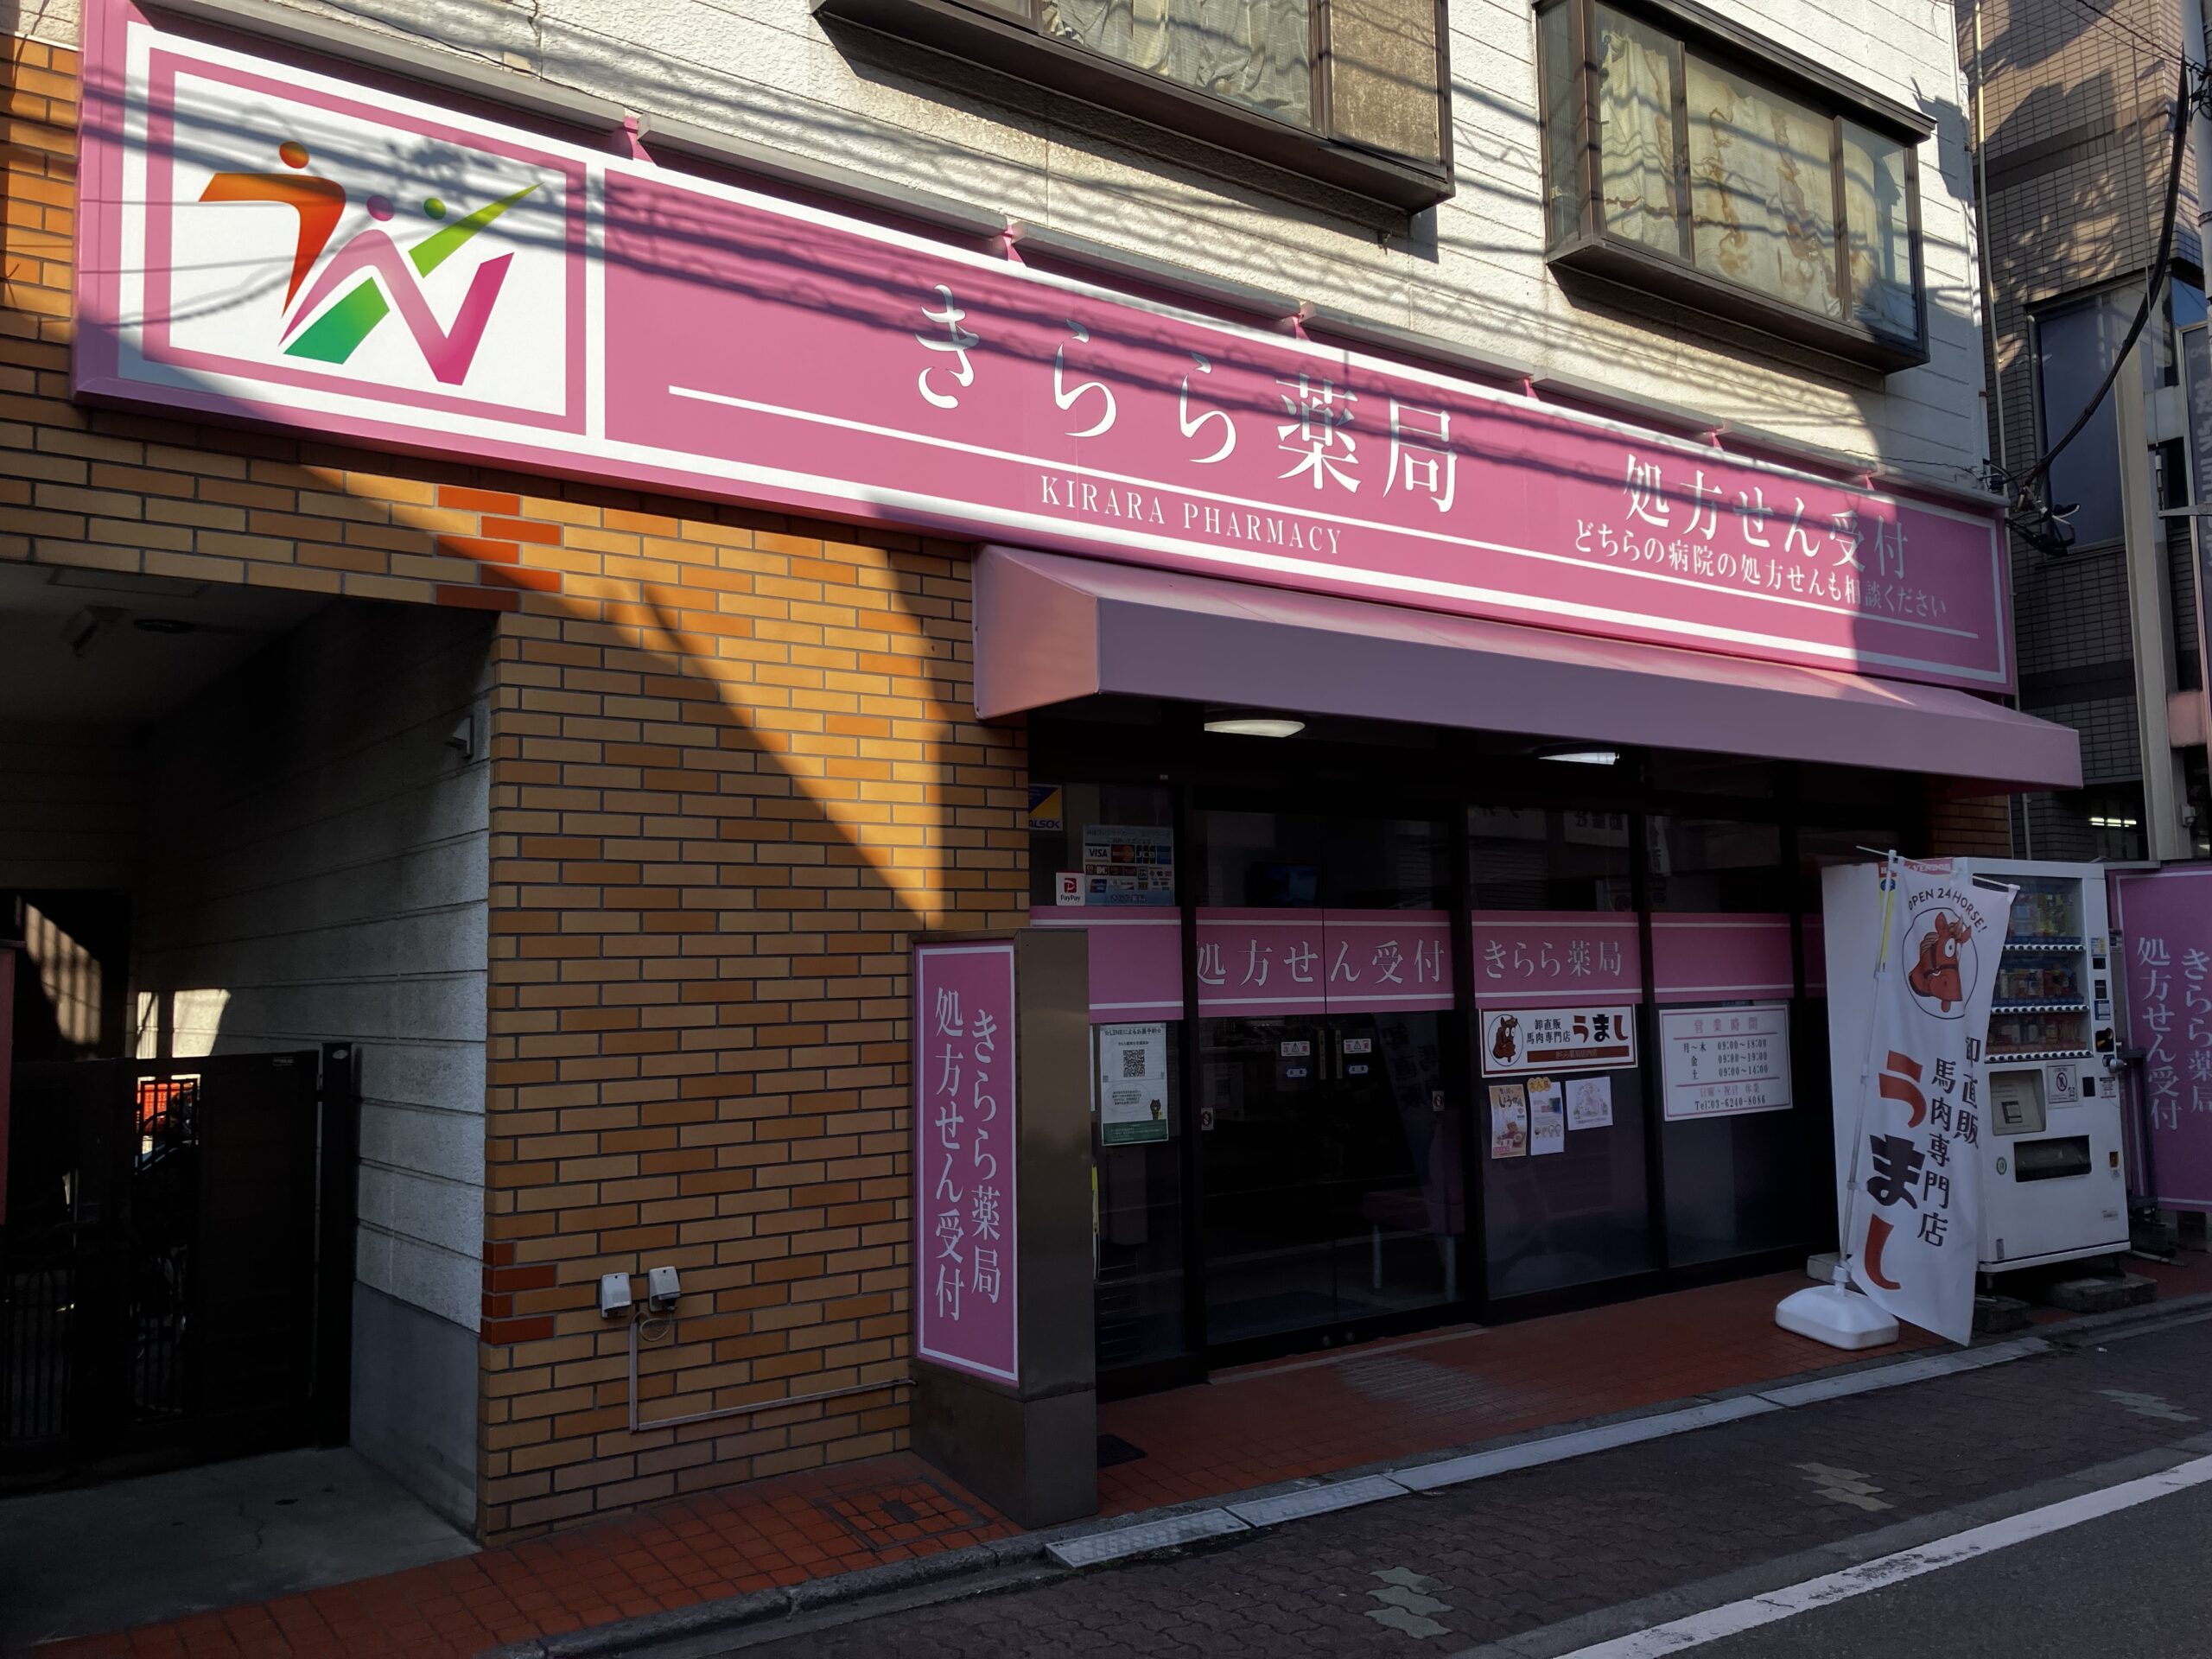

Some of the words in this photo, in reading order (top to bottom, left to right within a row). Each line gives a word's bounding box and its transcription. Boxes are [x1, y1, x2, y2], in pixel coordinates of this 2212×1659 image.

[914, 283, 1459, 513] きらら薬局
[1041, 475, 1166, 525] KIRARA
[1184, 502, 1343, 556] PHARMACY
[1623, 454, 1909, 579] 処方せん受付
[1575, 518, 1947, 619] どちらの病院の処方せんも相談ください
[1089, 849, 1108, 858] VISA
[1908, 888, 1935, 911] OPEN
[1937, 887, 1951, 899] 24
[1952, 891, 1987, 933] HORSE!
[1198, 939, 1445, 987] 処方せん受付
[1483, 939, 1622, 979] きらら薬局
[1527, 1031, 1571, 1044] 馬肉専門店
[1535, 1019, 1562, 1031] 卸直販
[1573, 1014, 1628, 1043] うまし
[1694, 1017, 1758, 1033] 営業時間
[2137, 937, 2183, 1131] 処方せん受付
[934, 987, 965, 1322] 処方せん受付
[971, 1008, 1001, 1305] きらら薬局
[1865, 1050, 1927, 1290] うまし
[1917, 1058, 1956, 1247] 馬肉専門店
